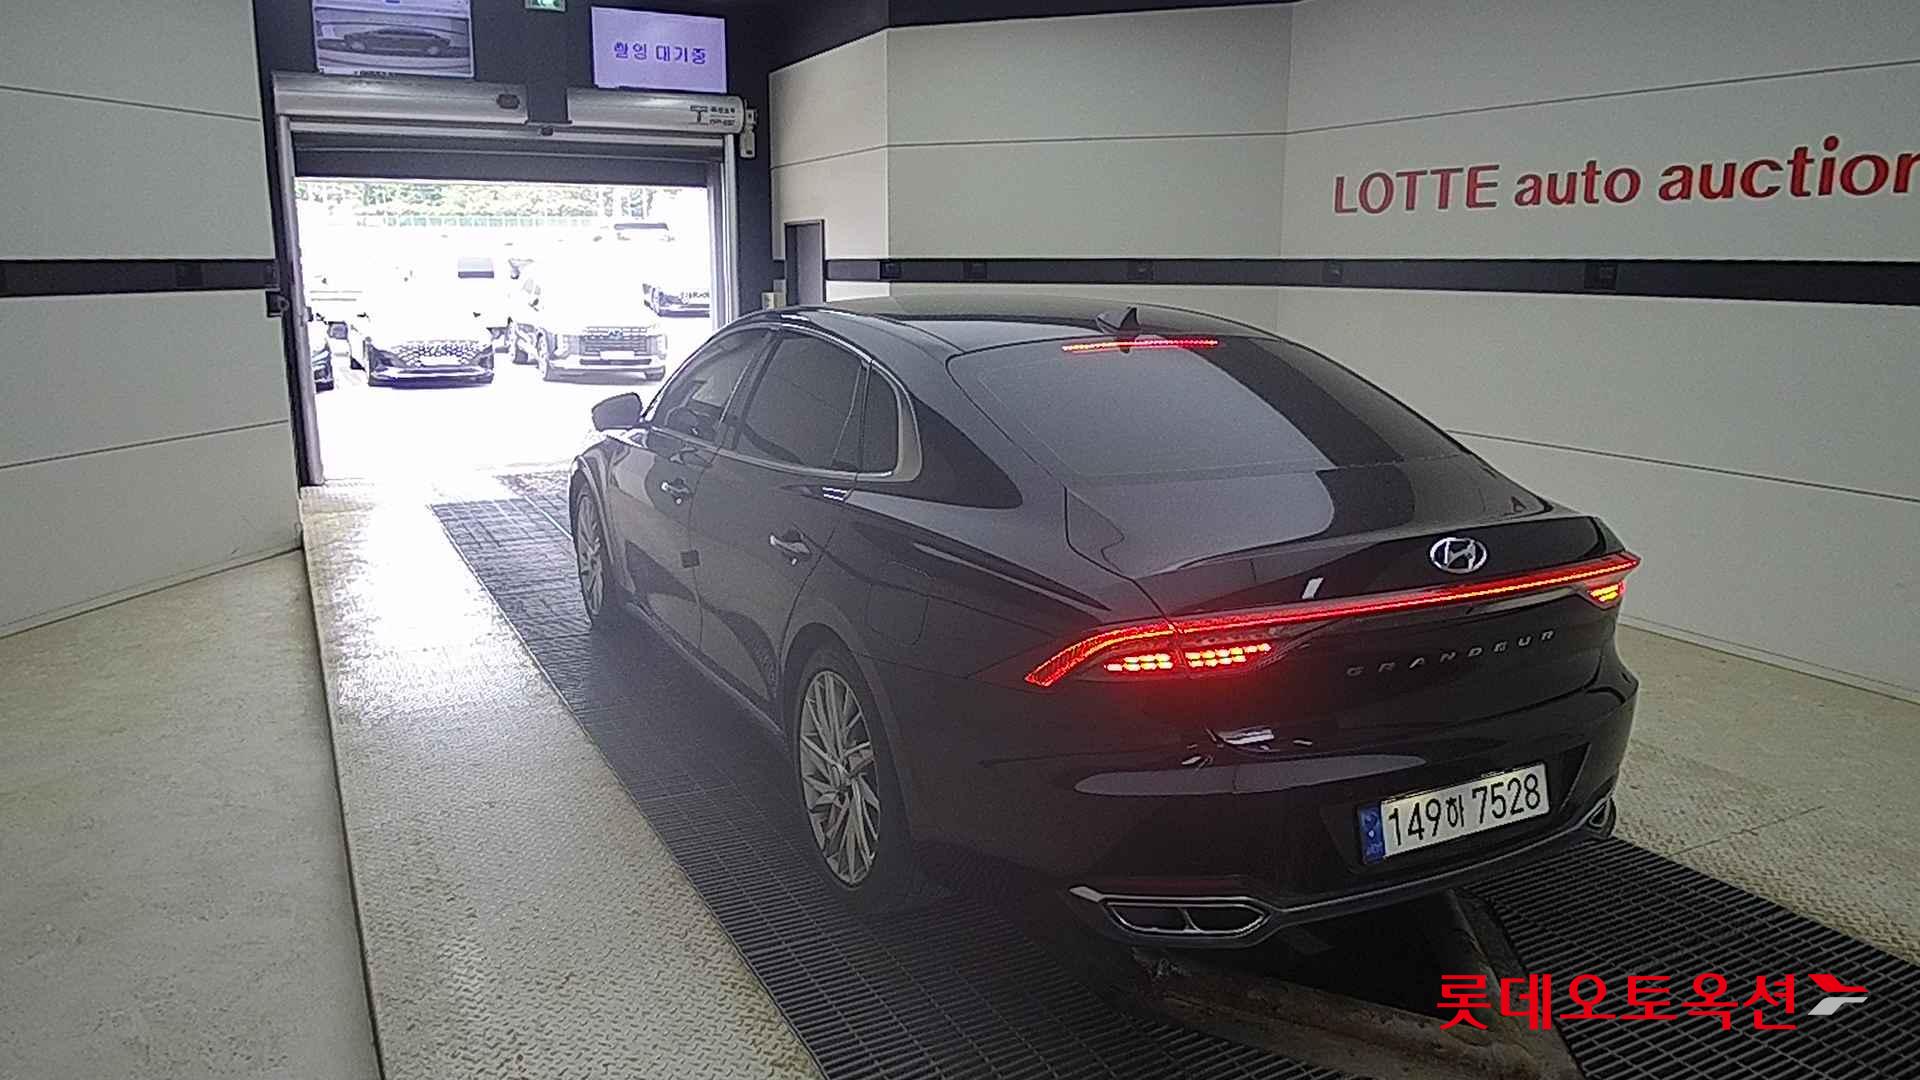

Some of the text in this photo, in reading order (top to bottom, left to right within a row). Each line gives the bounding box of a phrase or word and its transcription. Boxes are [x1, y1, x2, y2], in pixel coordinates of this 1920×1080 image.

[655, 44, 707, 65] 대기중
[1334, 164, 1500, 214] LOTTE
[1513, 160, 1642, 207] auto
[1346, 629, 1554, 677] GRANDEUR
[1388, 773, 1541, 846] 149하 7528
